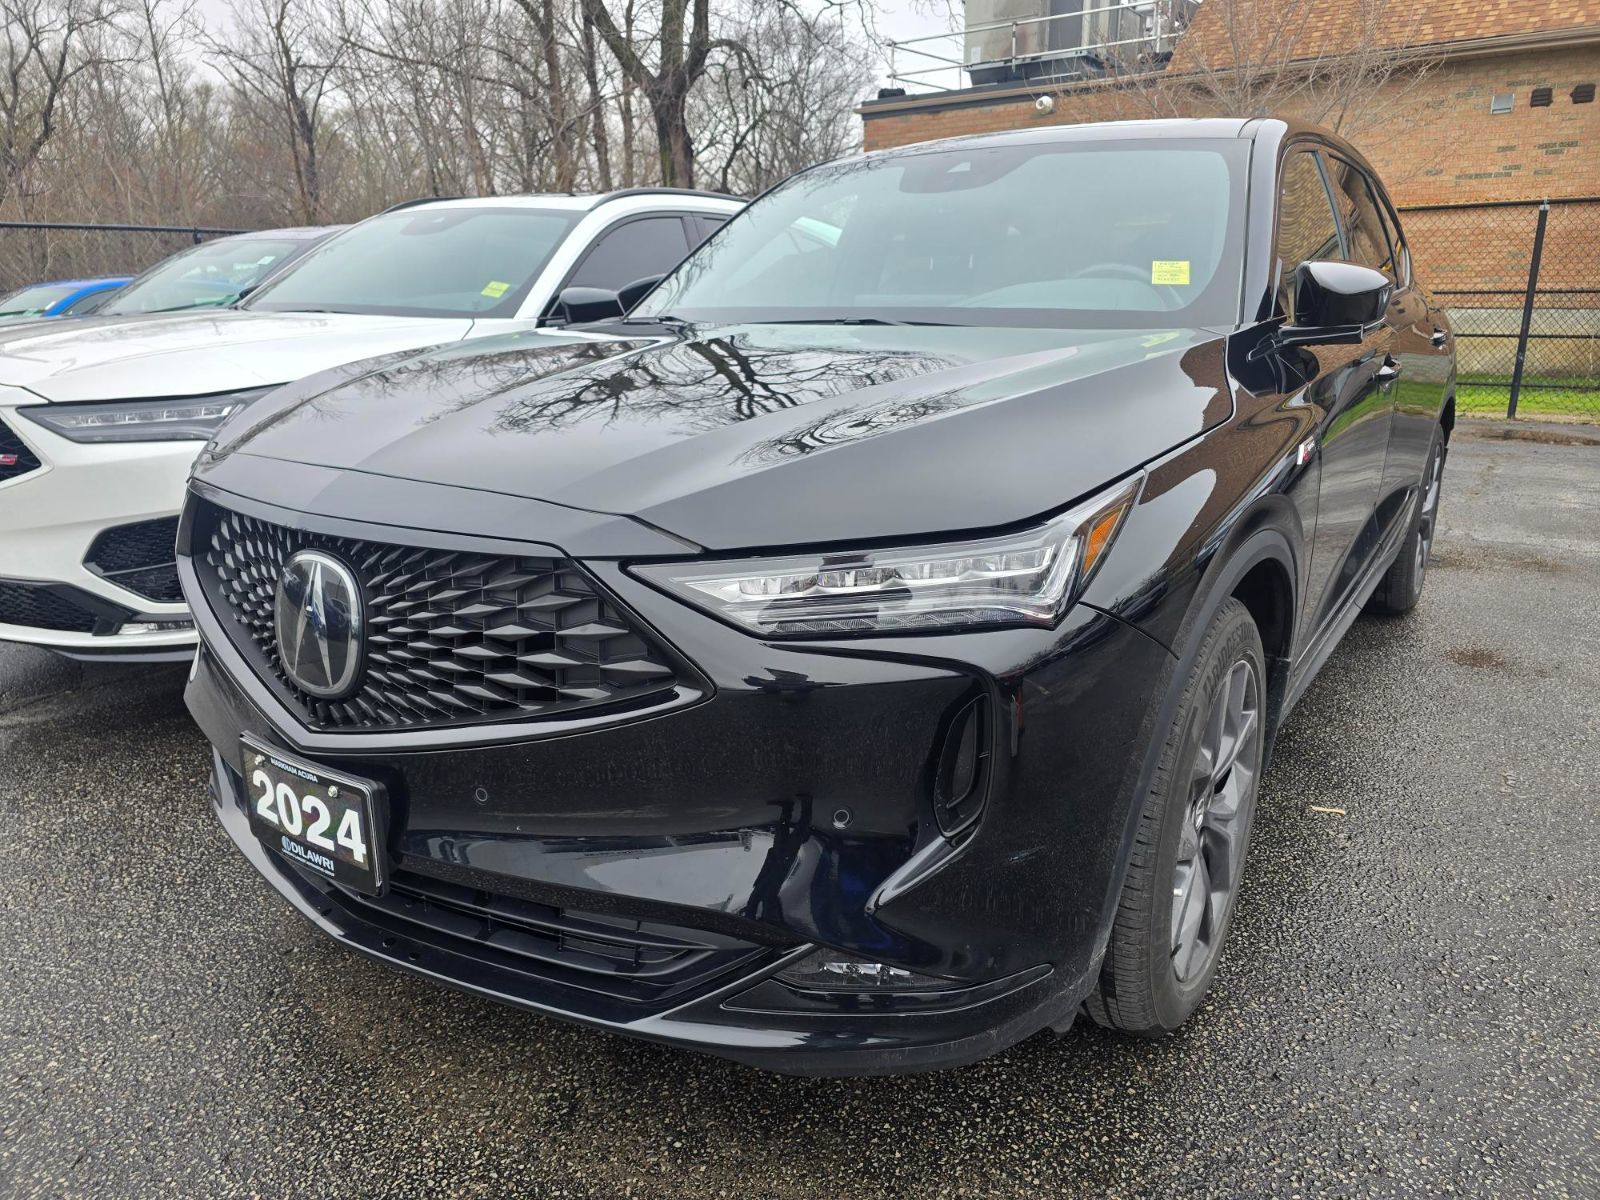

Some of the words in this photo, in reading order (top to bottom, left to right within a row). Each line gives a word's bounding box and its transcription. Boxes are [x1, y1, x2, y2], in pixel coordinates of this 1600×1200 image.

[270, 757, 298, 775] MARKHAM
[297, 770, 319, 783] ACURA
[253, 770, 366, 863] 2024
[290, 841, 335, 871] DILAWRI
